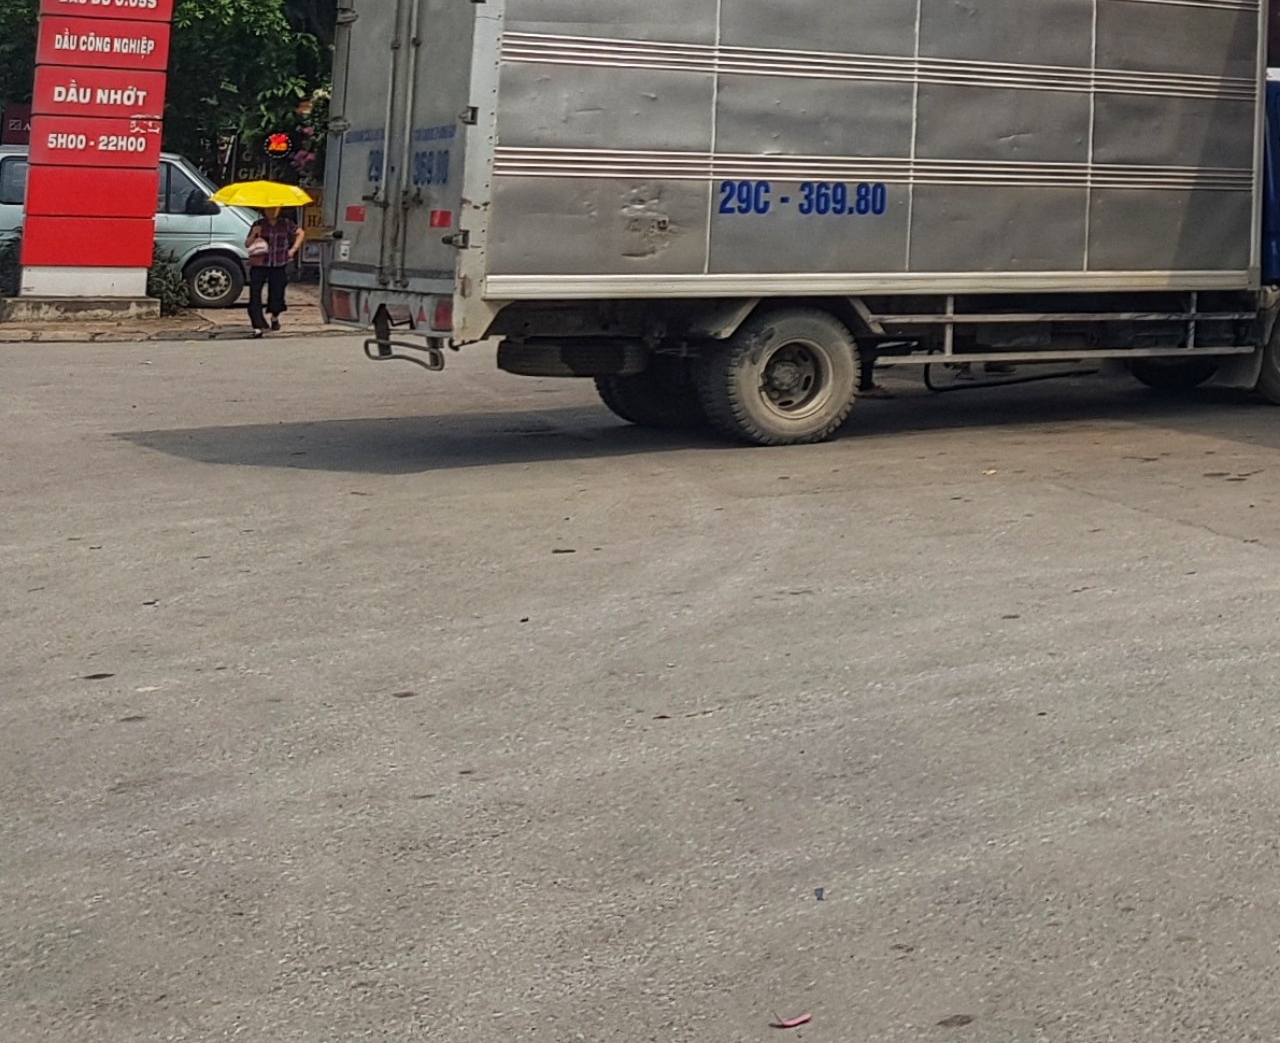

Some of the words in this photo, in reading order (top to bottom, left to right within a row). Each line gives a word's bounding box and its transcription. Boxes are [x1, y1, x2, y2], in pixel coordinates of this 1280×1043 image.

[55, 28, 77, 50] DẦU
[79, 32, 111, 52] CÔNG
[113, 36, 155, 59] NGHIỆP
[53, 79, 91, 103] DẦU
[96, 85, 147, 106] NHỚT
[47, 133, 86, 149] 5H00
[98, 136, 146, 152] 22H00
[719, 180, 771, 215] 29C
[798, 181, 887, 215] 369.80
